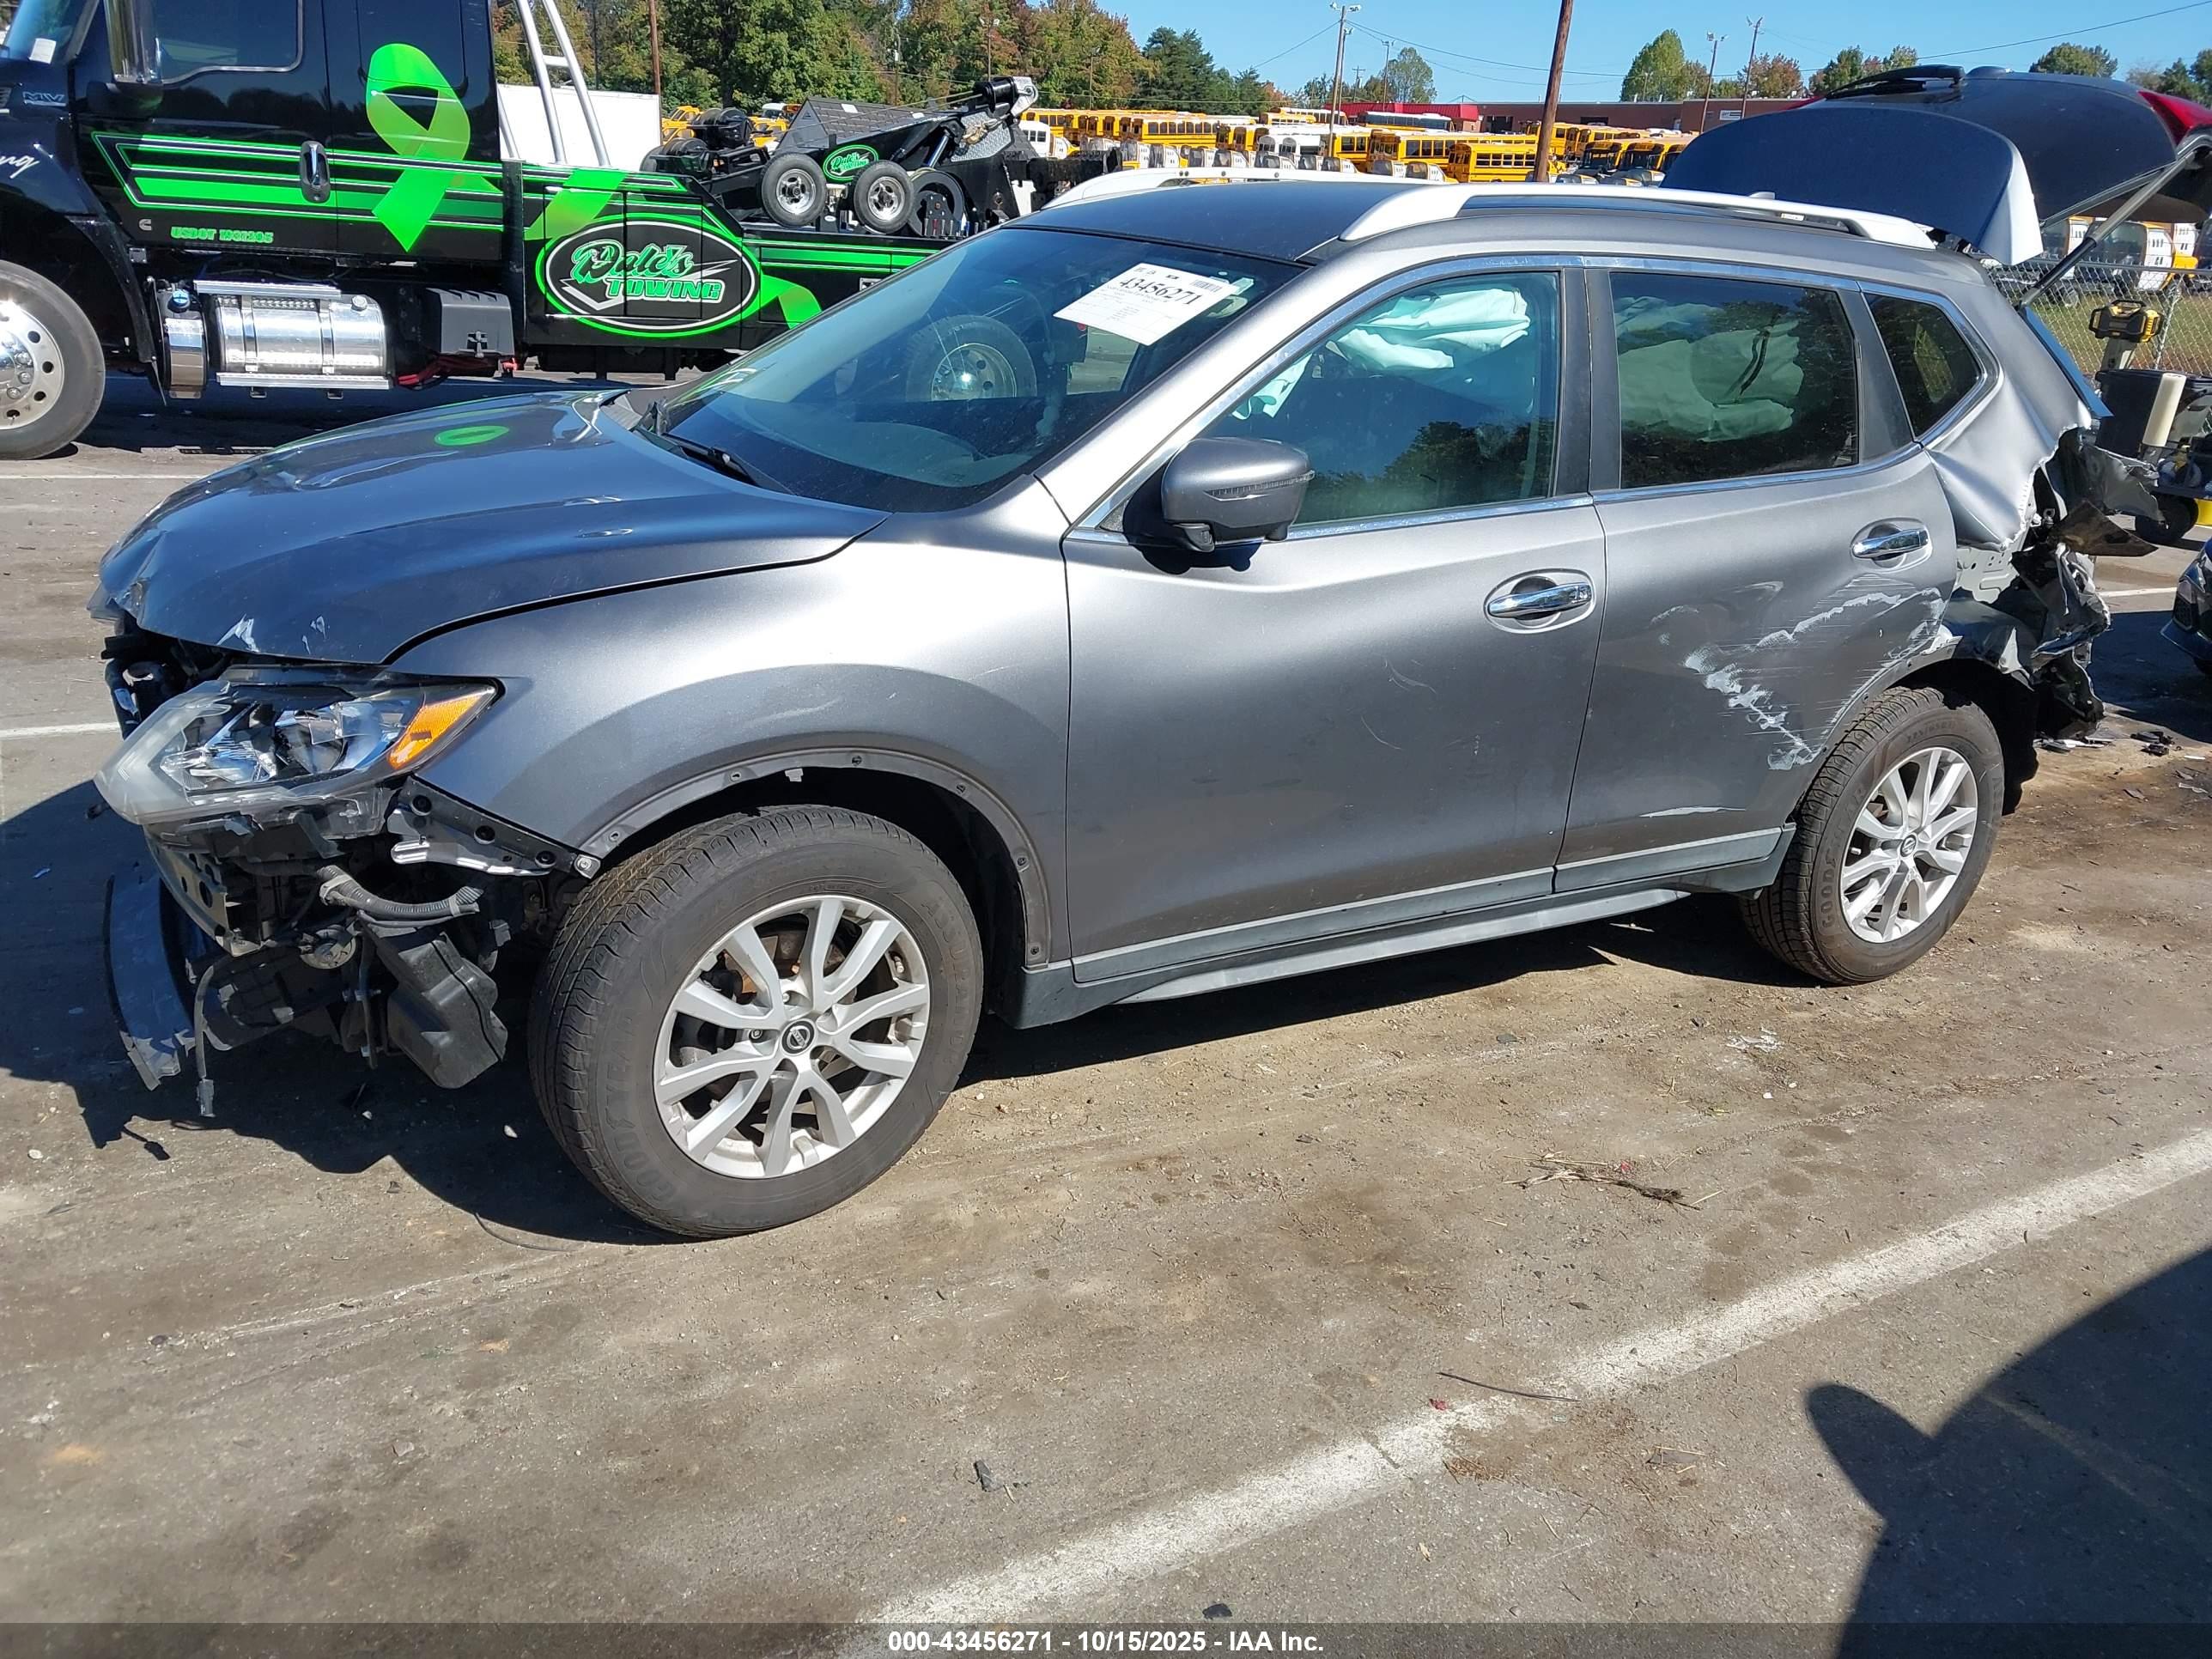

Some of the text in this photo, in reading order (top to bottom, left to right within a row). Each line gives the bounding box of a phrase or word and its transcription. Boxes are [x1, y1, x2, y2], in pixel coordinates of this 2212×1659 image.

[22, 91, 65, 102] MV
[171, 226, 217, 240] USDOT
[570, 240, 695, 284] Dale's
[605, 277, 725, 303] TOWING
[1119, 276, 1202, 306] 43456271
